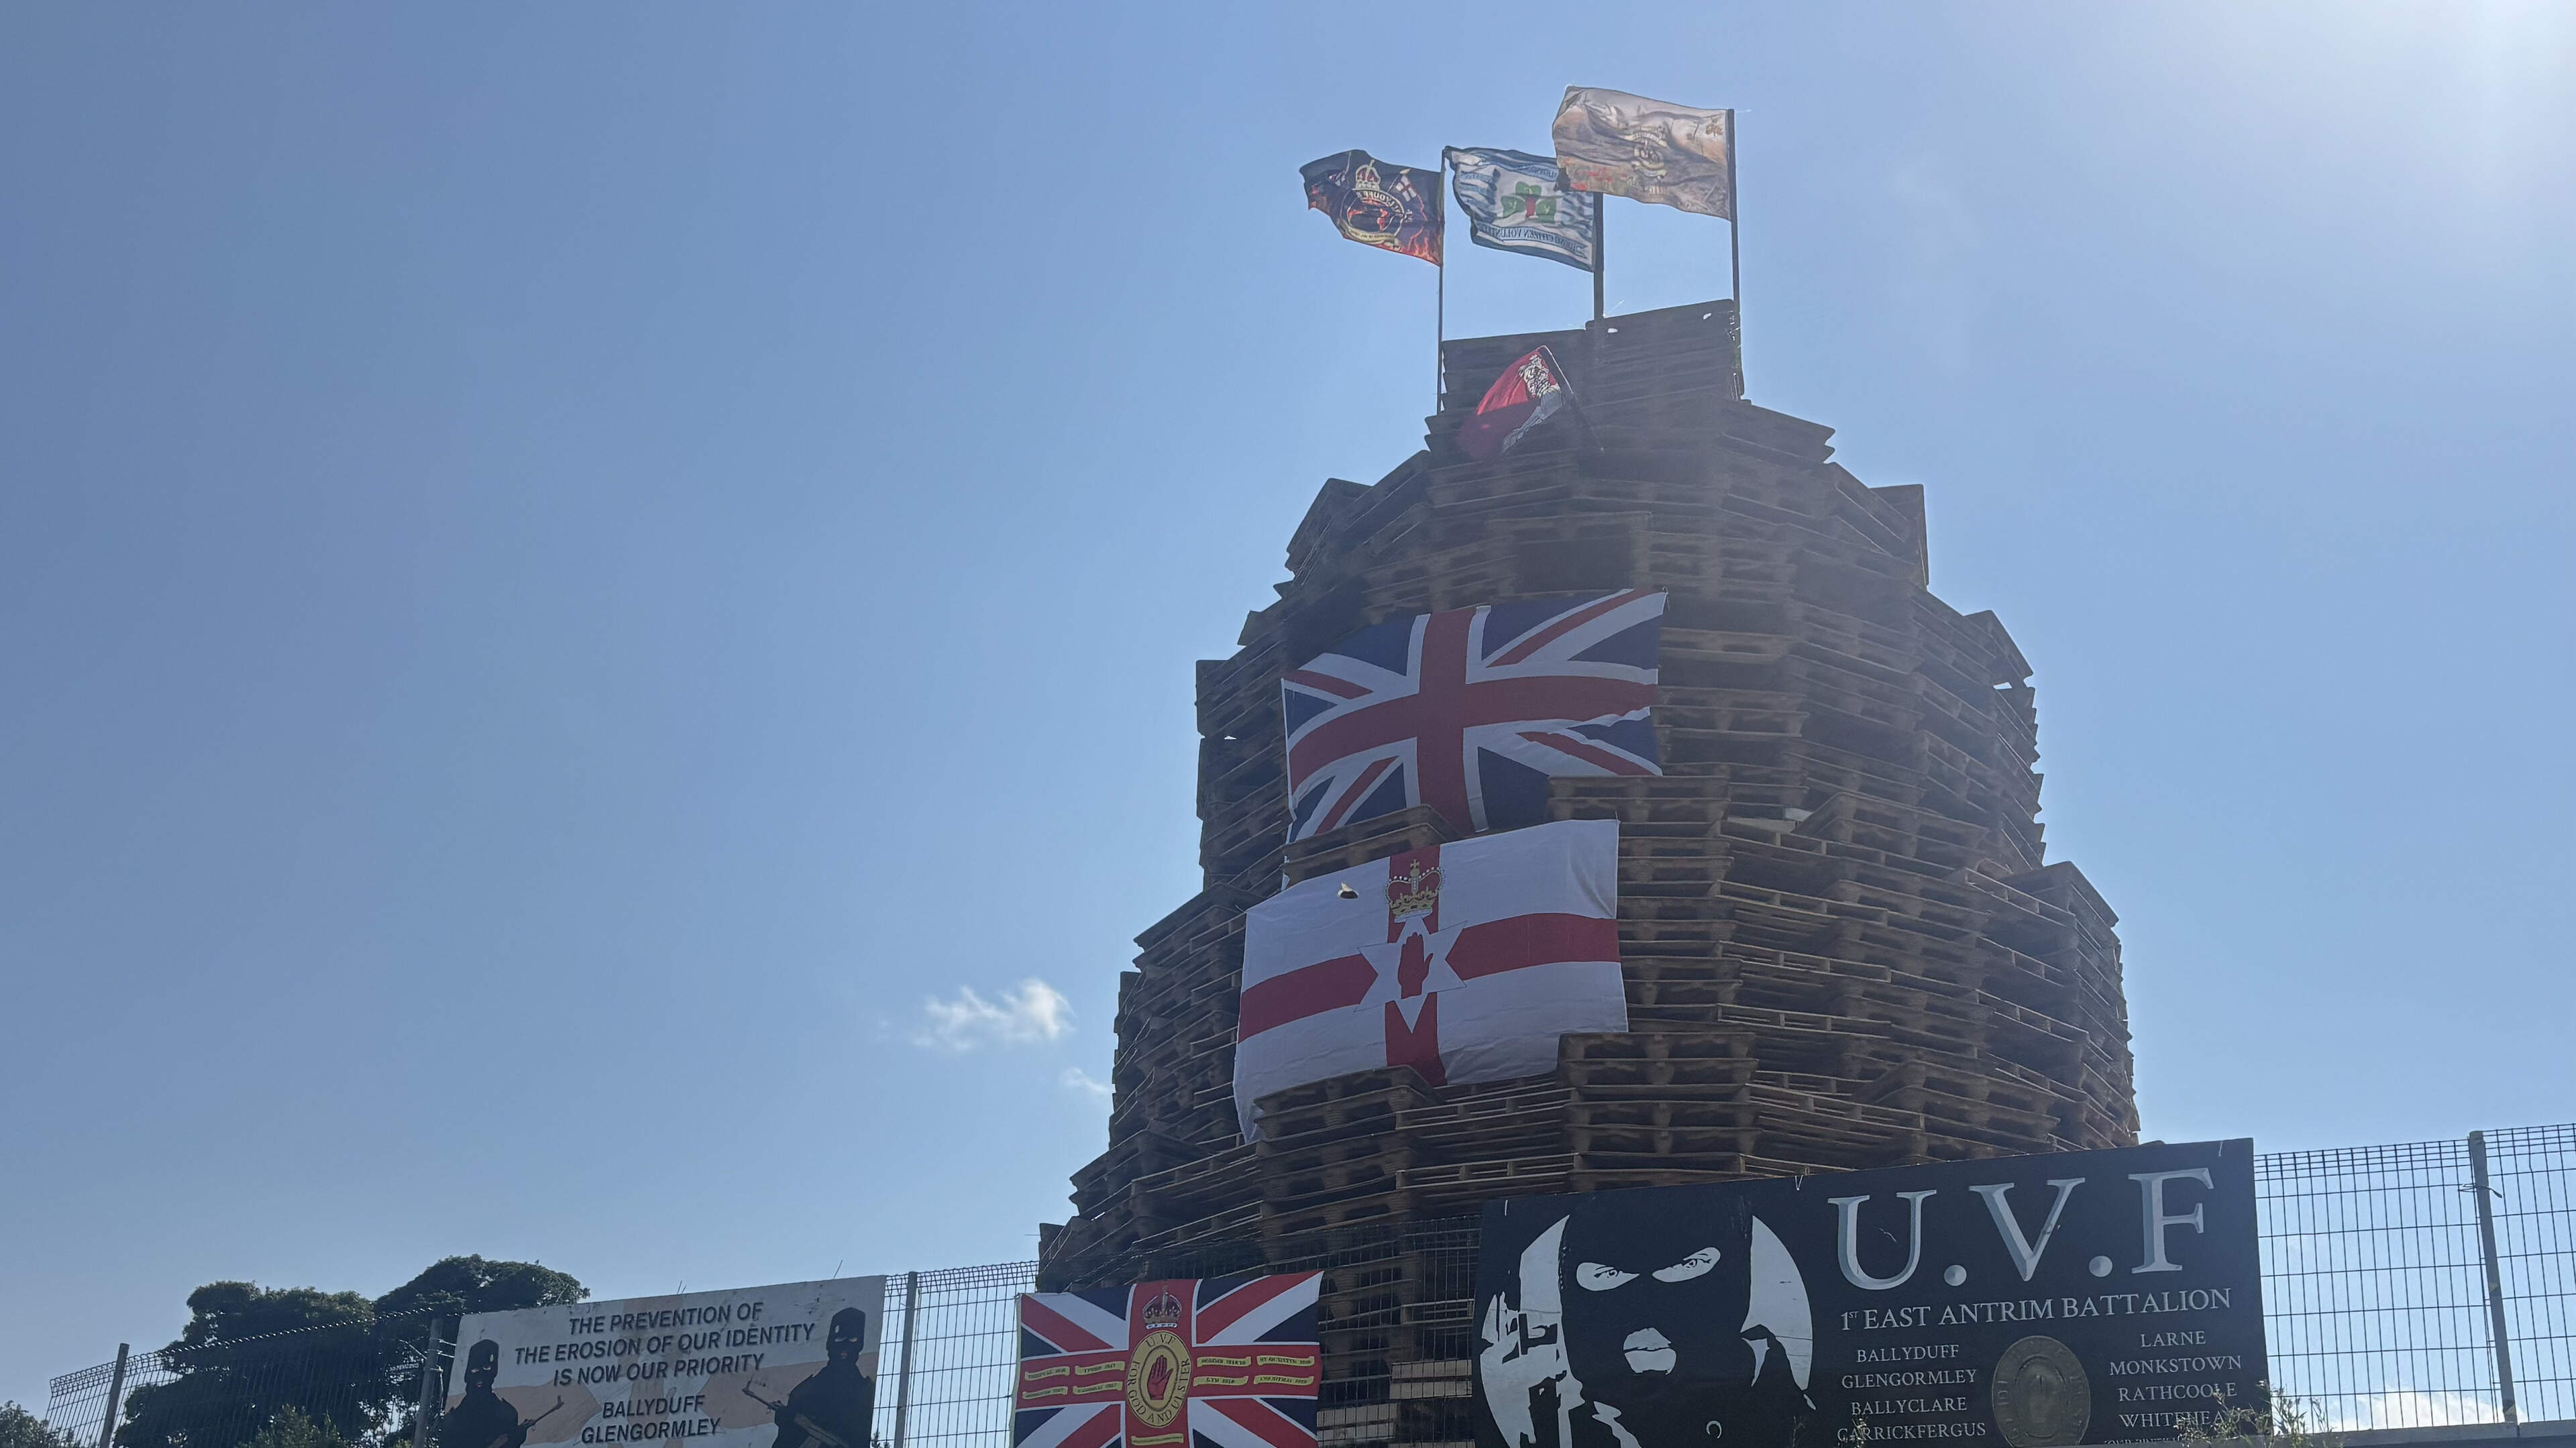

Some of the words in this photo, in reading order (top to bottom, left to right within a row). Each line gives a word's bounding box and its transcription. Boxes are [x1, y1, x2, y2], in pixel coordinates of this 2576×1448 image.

[570, 1316, 606, 1335] THE
[610, 1304, 731, 1332] PREVENTION
[737, 1302, 763, 1321] OF
[1863, 1306, 1931, 1330] EAST
[1938, 1299, 2053, 1325] ANTRIM
[2061, 1288, 2231, 1319] BATTALION
[515, 1345, 551, 1365] THE
[554, 1338, 641, 1361] EROSION
[647, 1335, 674, 1354] OF
[678, 1331, 721, 1351] OUR
[725, 1323, 816, 1348] IDENTITY
[2140, 1331, 2206, 1348] LARNE
[1856, 1344, 1960, 1363] BALLYDUFF
[553, 1368, 572, 1386] IS
[577, 1364, 621, 1385] NOW
[627, 1361, 668, 1382] OUR
[674, 1353, 765, 1378] PRIORITY
[1127, 1361, 1140, 1386] FOR
[2109, 1355, 2242, 1376] MONKSTOWN
[1172, 1357, 1191, 1408] ULSTER
[1841, 1370, 1977, 1389] GLENGORMLEY
[1128, 1390, 1146, 1415] GOD
[2118, 1383, 2238, 1402] RATHCOOLE
[602, 1394, 705, 1419] BALLYDUFF
[1146, 1410, 1173, 1424] AND
[1851, 1397, 1968, 1416] BALLYCLARE
[581, 1417, 721, 1443] GLENGORMLEY
[2118, 1410, 2239, 1428] WHITEHEA
[1837, 1423, 1986, 1441] CARRICKFERGUS
